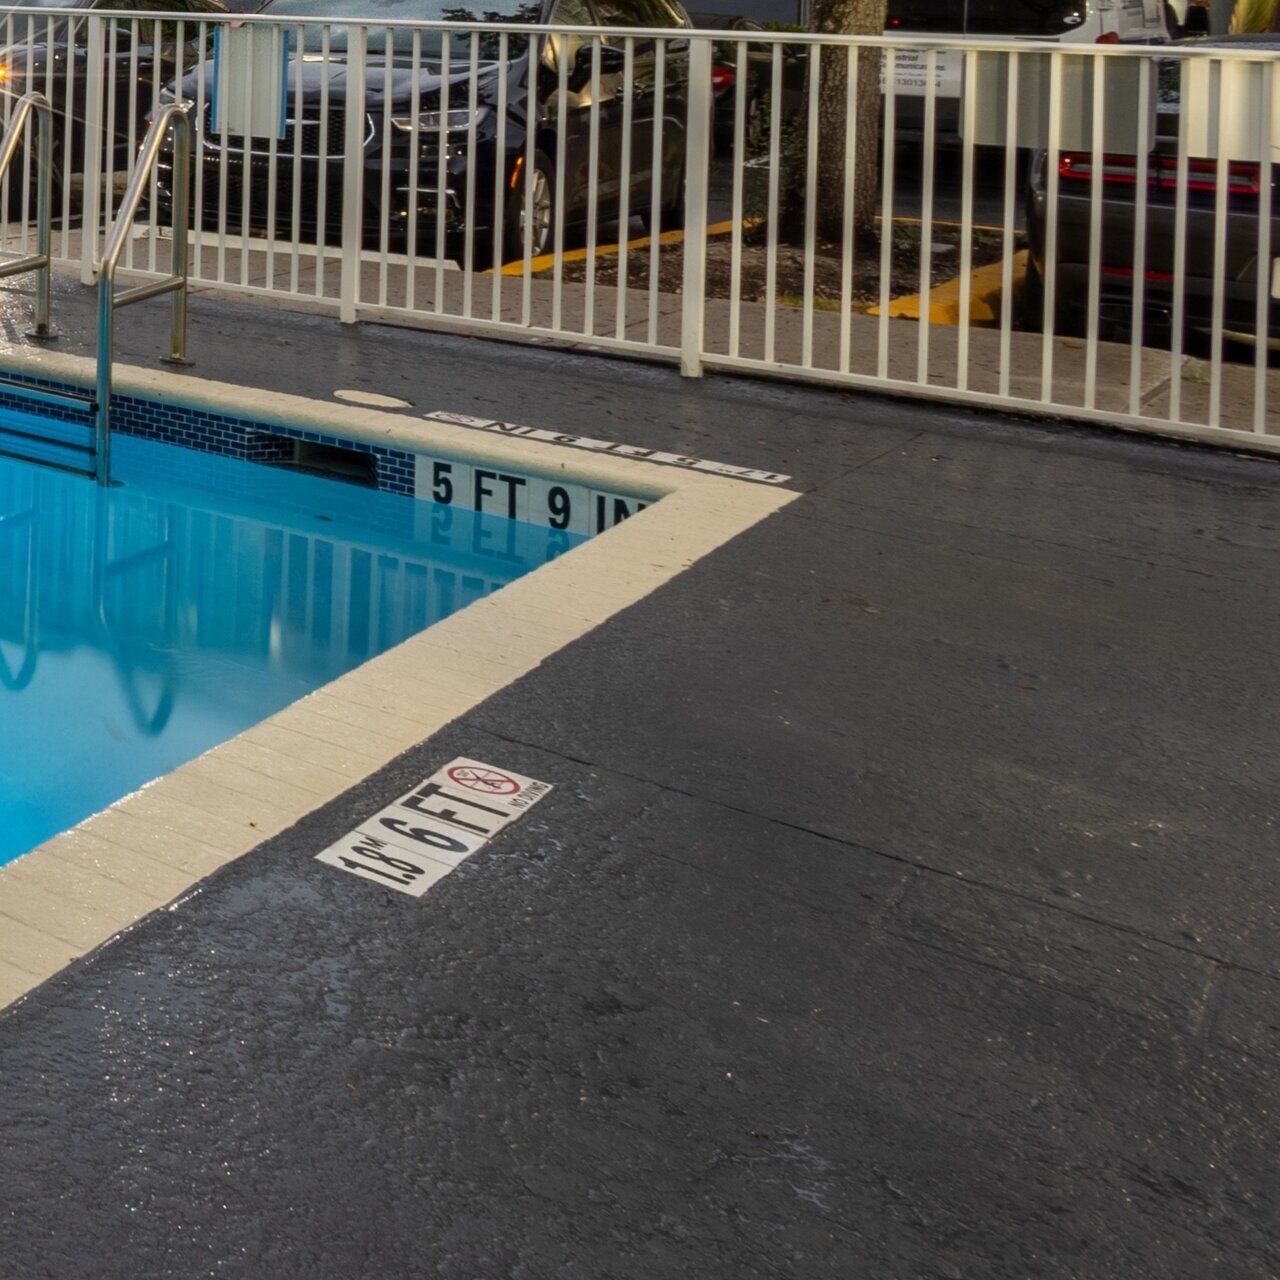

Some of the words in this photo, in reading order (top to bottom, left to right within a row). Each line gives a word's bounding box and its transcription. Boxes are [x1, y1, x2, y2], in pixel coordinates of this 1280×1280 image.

[482, 422, 538, 435] IN
[553, 434, 582, 443] 9
[432, 461, 453, 504] 5
[474, 469, 527, 520] FT
[547, 486, 571, 530] 9
[400, 782, 510, 835] FT
[379, 817, 469, 853] 6
